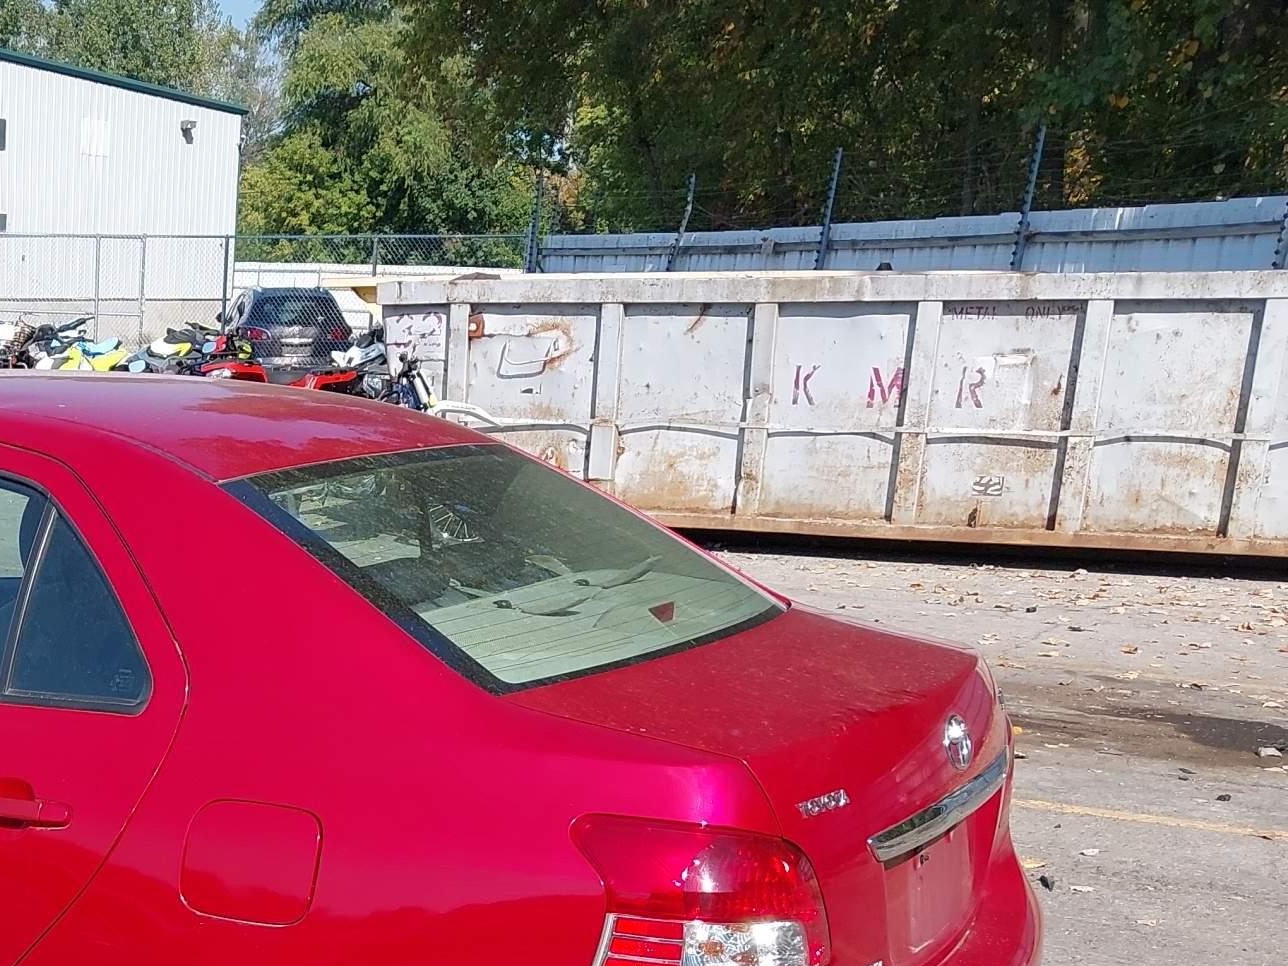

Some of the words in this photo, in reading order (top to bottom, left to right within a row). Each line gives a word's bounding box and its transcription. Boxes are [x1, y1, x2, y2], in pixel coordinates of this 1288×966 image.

[791, 365, 821, 406] K
[866, 366, 906, 409] M
[954, 366, 987, 409] R
[794, 789, 850, 819] TOYOTA
